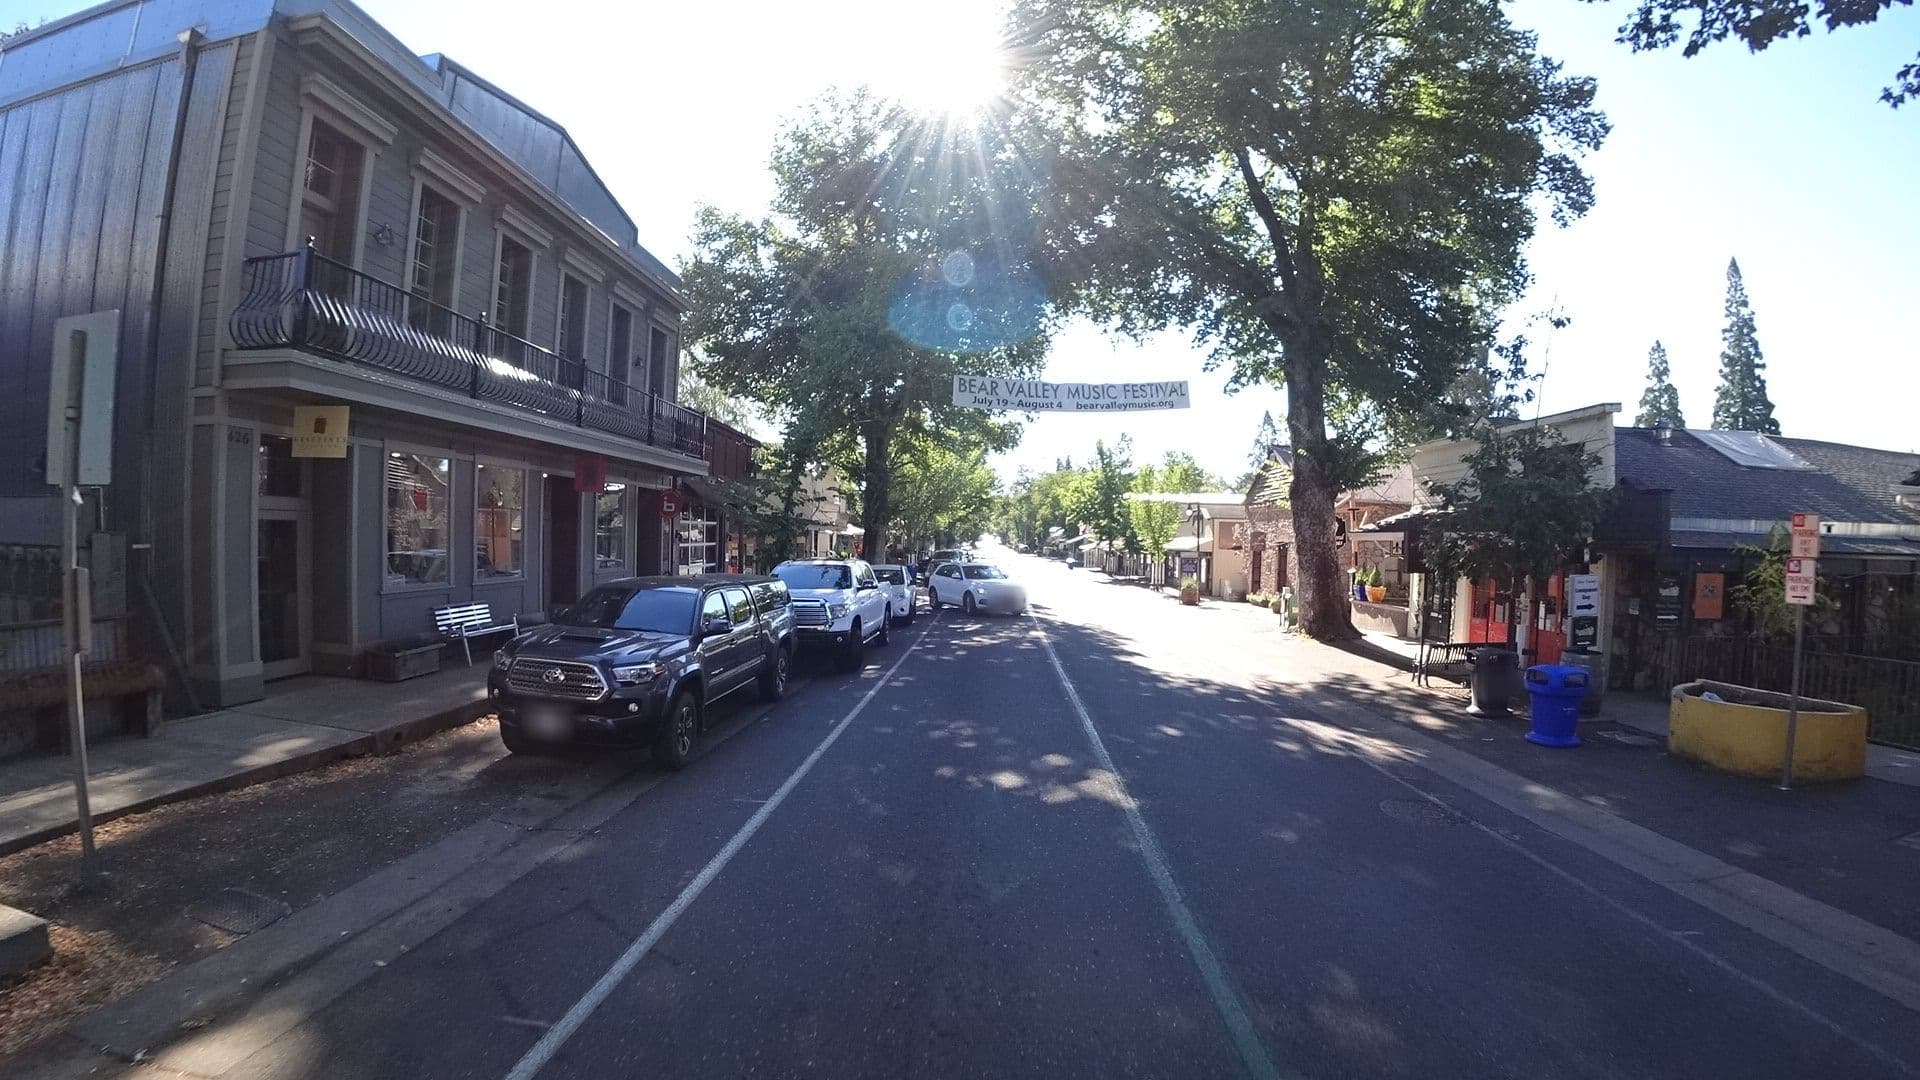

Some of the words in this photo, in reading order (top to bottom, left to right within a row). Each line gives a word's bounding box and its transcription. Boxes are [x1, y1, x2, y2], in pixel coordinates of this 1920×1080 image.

[958, 377, 999, 396] BEAR
[1005, 381, 1060, 399] VALLEY
[1067, 384, 1118, 400] MUSIC
[1123, 382, 1186, 400] FESTIVAL
[972, 396, 993, 407] July
[996, 399, 1009, 407] 19
[1017, 400, 1054, 411] August
[1056, 401, 1063, 409] 4
[1076, 400, 1175, 411] bearvalleymusic.org
